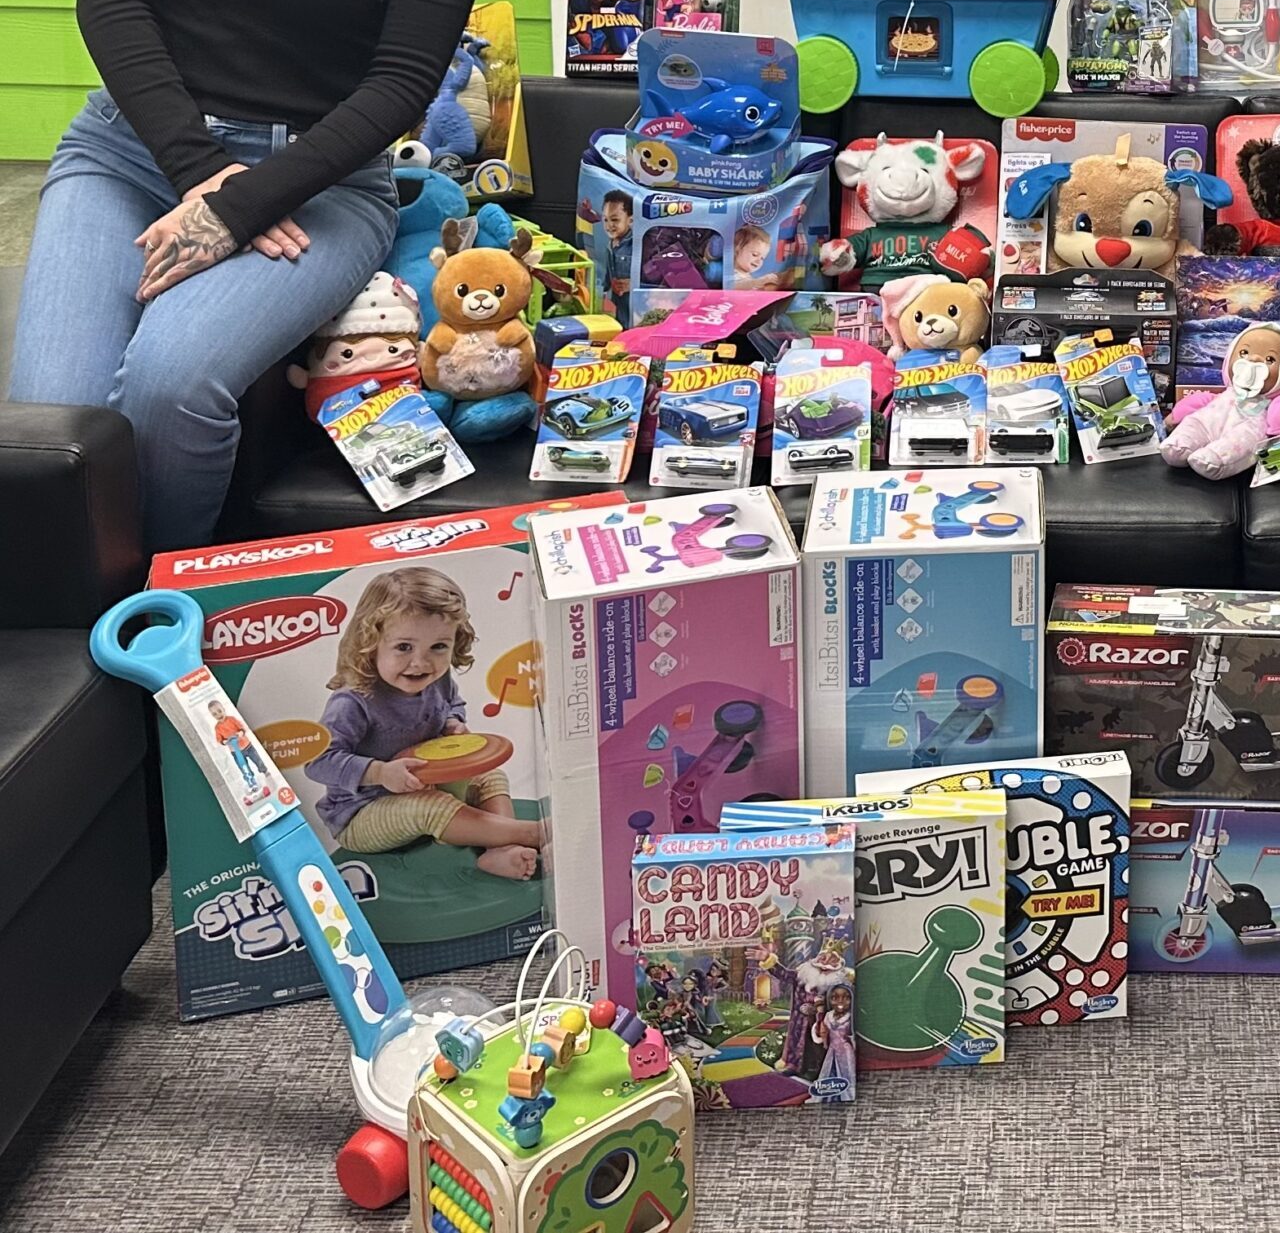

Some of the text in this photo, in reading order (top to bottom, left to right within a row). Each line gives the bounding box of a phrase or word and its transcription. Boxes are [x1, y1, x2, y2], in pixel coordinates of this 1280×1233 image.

[569, 13, 643, 35] SPIDER-MAN
[568, 63, 638, 72] TITAN HERO SERIES
[646, 121, 684, 136] TRY ME!
[1019, 122, 1073, 136] fisher-price
[688, 166, 764, 180] BABY SHARK
[711, 159, 742, 169] pinkfong
[652, 200, 694, 218] BLOKS
[1006, 221, 1027, 230] Press
[871, 235, 929, 257] MOOEY
[945, 243, 968, 264] MILK
[688, 301, 734, 327] Barbie
[559, 366, 593, 389] HOT
[903, 368, 936, 387] HOT
[1069, 357, 1098, 381] HOT
[670, 371, 705, 393] HOT
[784, 375, 818, 396] HOT
[338, 401, 373, 438] HOT
[173, 539, 334, 576] PLAYSKOOL
[871, 562, 879, 584] blocks
[872, 585, 881, 600] play
[872, 600, 880, 615] and
[203, 607, 338, 650] AYSKOOL
[819, 561, 839, 688] ItsiBitsi BLOCKS
[853, 563, 866, 685] 4-wheel balance ride-on
[872, 638, 880, 654] with
[1089, 643, 1187, 666] Razor
[567, 604, 590, 737] ItsiBitsi BLOCKS
[604, 602, 618, 727] 4-wheel balance ride-on
[262, 732, 321, 749] -powered
[272, 749, 300, 759] FUN!
[1059, 751, 1123, 768] TROUBLE
[824, 798, 910, 818] SORRY!
[856, 823, 941, 844] Sweet Revenge
[1131, 820, 1190, 839] zor
[1006, 814, 1118, 867] UBLE
[1056, 857, 1104, 876] GAME
[183, 862, 262, 899] THE ORIGIN
[638, 858, 800, 905] CANDY
[1031, 893, 1096, 913] TRY ME!
[640, 901, 761, 945] LAND
[1014, 928, 1066, 973] IN THE BUBBLE
[964, 1039, 997, 1051] Hasbro
[813, 1079, 847, 1091] Hasbro
